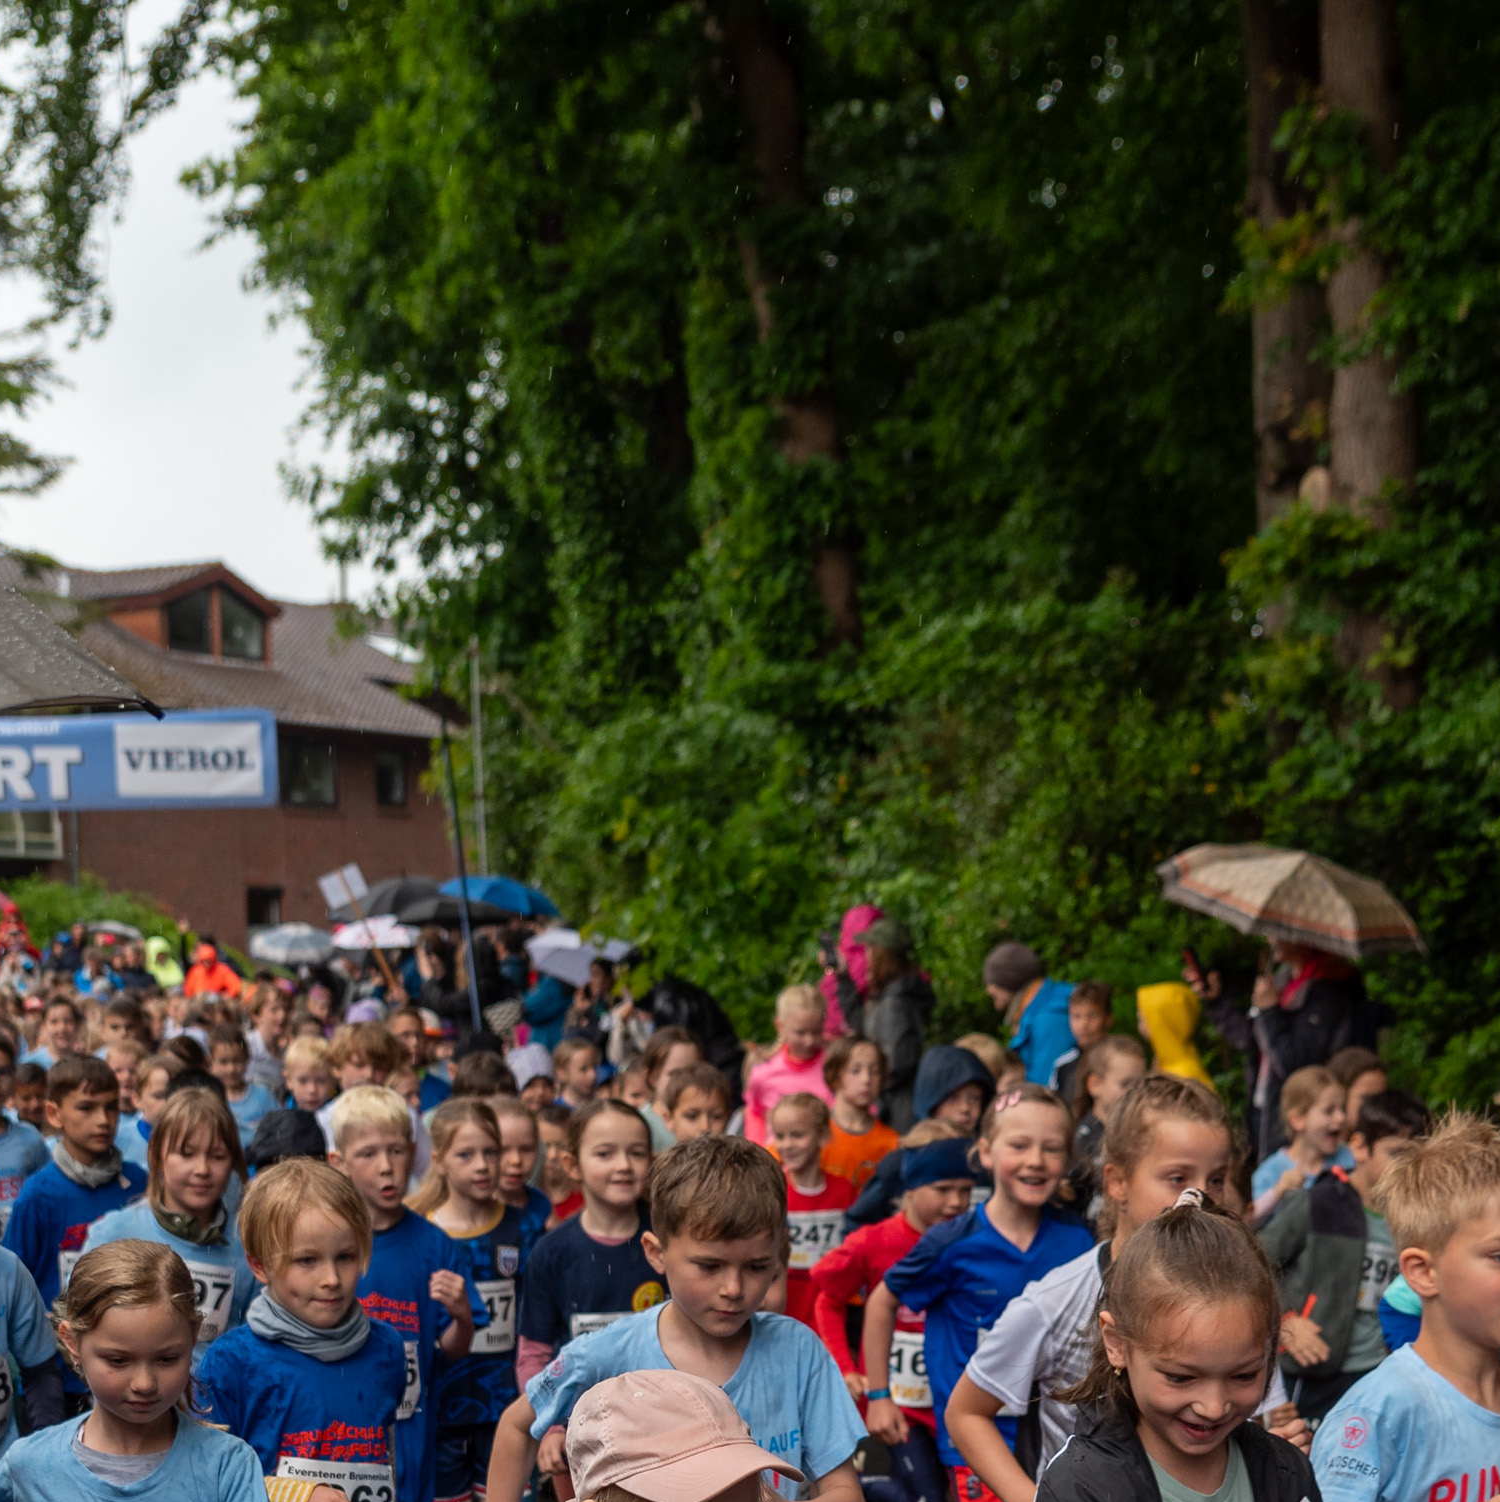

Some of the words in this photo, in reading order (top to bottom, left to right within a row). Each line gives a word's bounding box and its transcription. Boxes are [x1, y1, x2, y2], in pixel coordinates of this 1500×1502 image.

[122, 746, 255, 773] VIEROL
[287, 1465, 347, 1480] Everstener
[349, 1471, 390, 1481] Brunnenlauf
